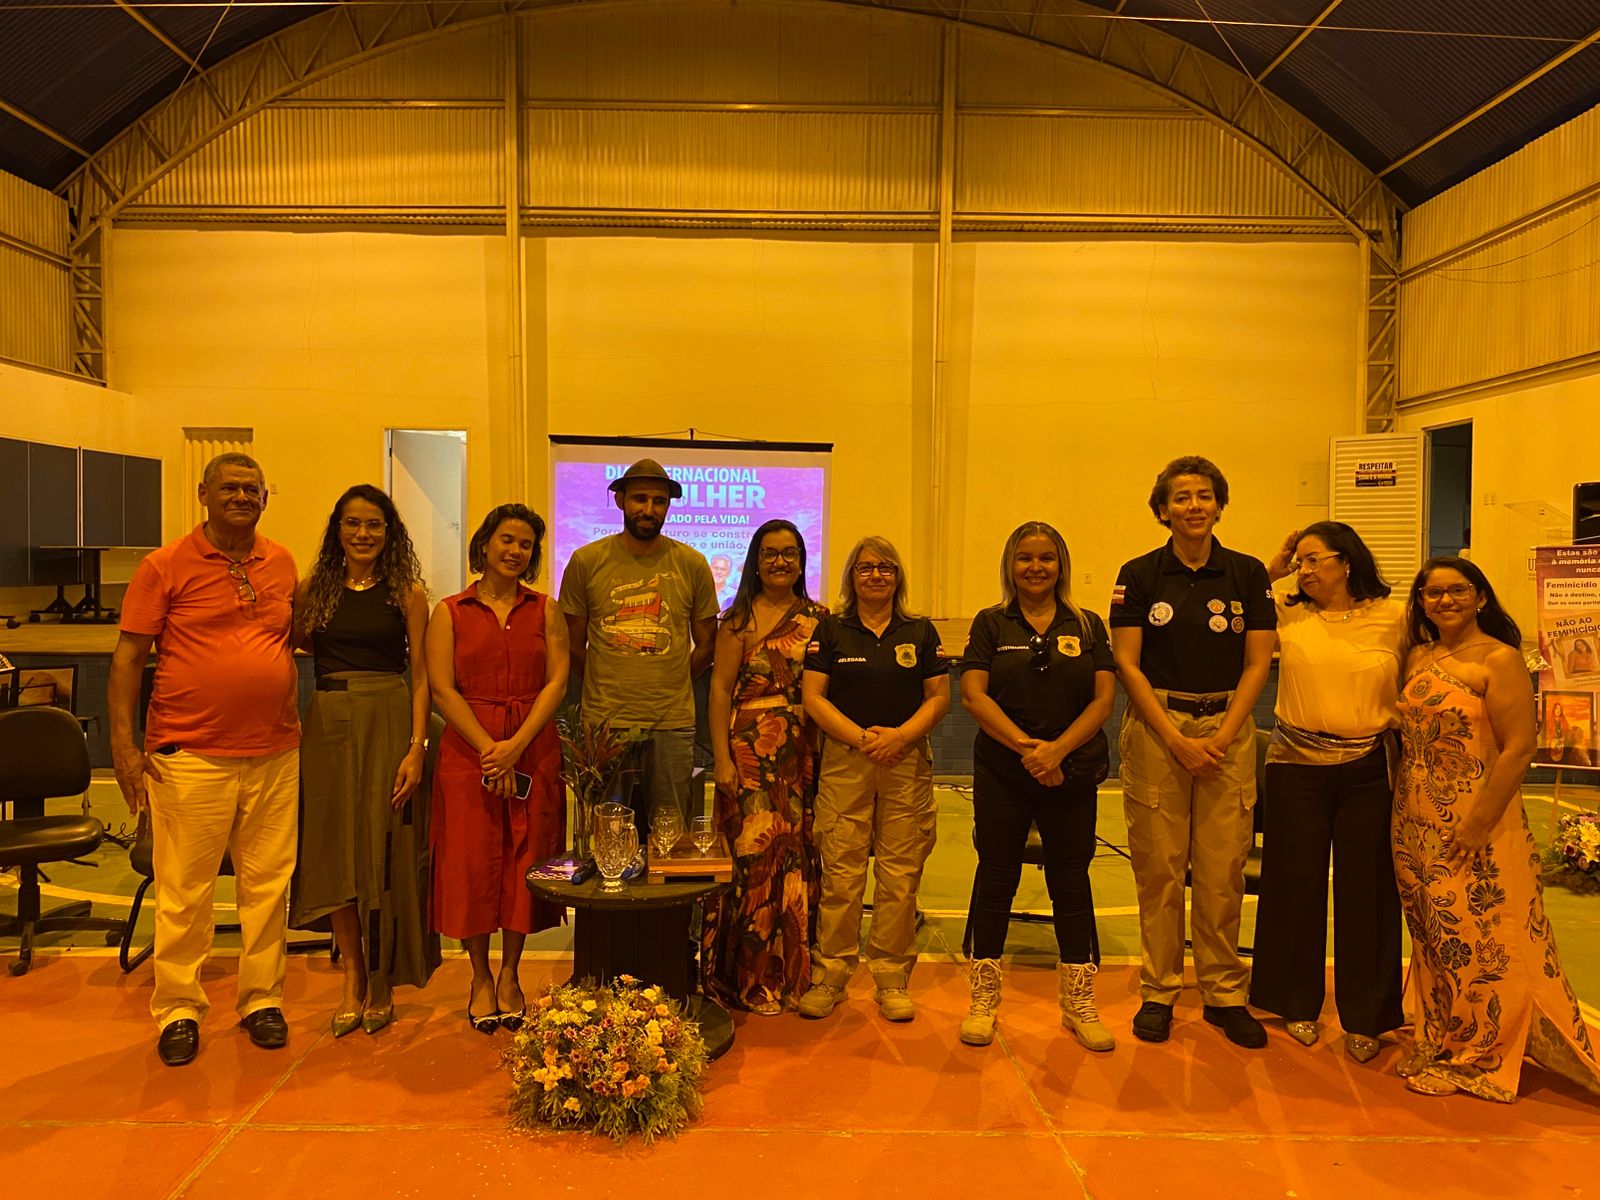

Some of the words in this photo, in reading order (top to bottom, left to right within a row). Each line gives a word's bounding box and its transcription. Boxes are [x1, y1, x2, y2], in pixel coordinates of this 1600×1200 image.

[1359, 462, 1393, 470] RESPEITAR
[664, 467, 760, 483] ERNACIONAL
[670, 484, 766, 509] ULHER
[694, 515, 717, 524] PELA
[720, 515, 750, 525] VIDA!
[694, 530, 708, 538] se
[711, 530, 753, 539] constr
[699, 541, 708, 549] e
[710, 539, 747, 550] união.
[1556, 619, 1576, 628] NÃO
[1579, 617, 1592, 625] AO
